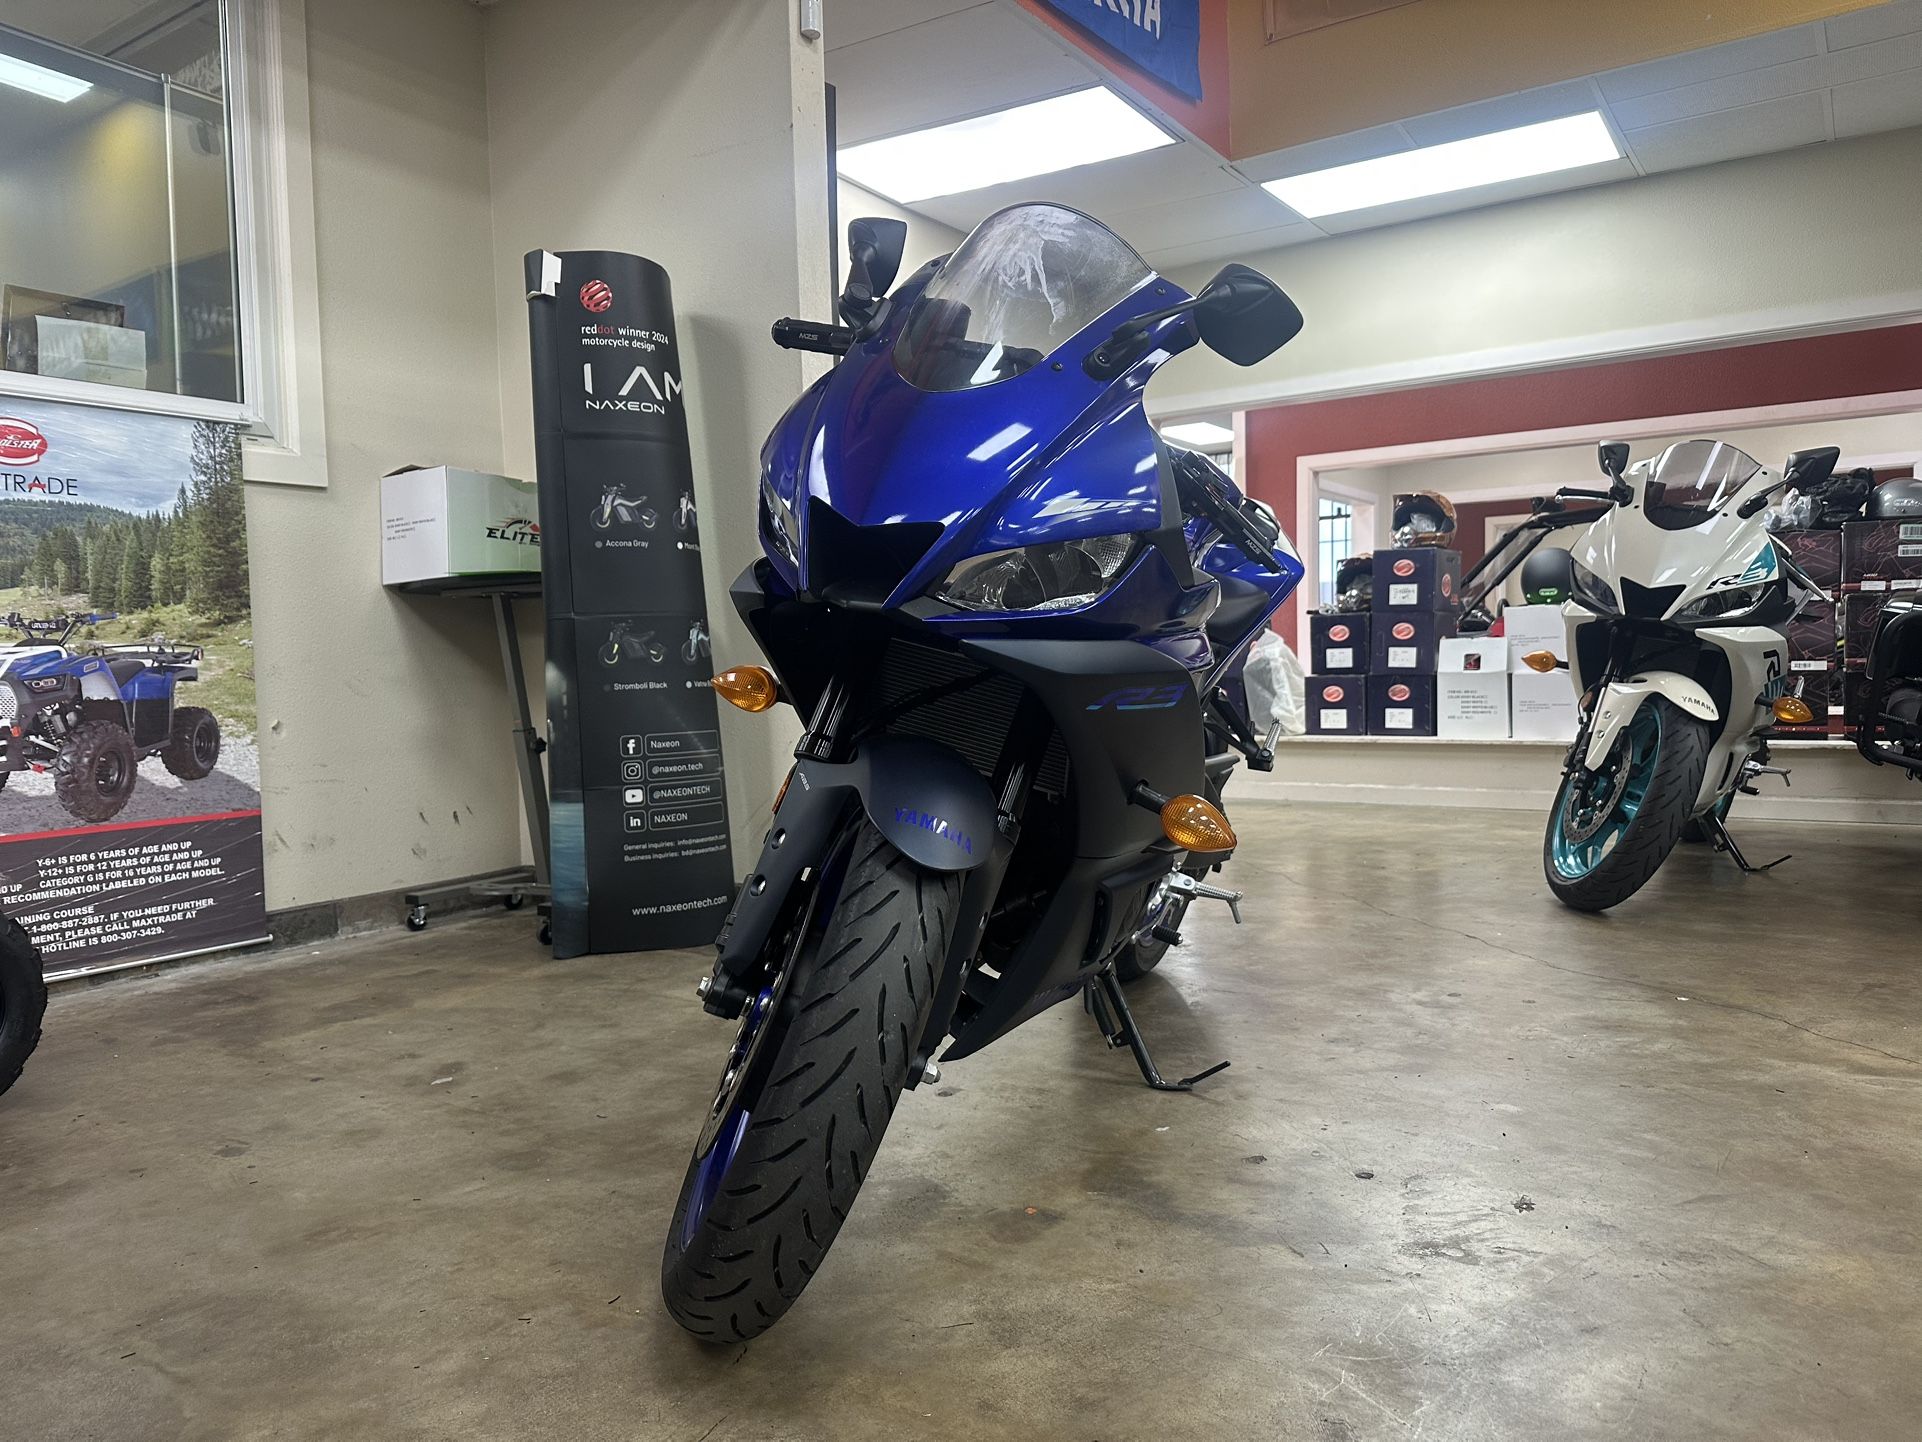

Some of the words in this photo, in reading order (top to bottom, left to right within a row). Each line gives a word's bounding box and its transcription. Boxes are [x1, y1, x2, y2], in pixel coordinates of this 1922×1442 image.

[581, 324, 614, 334] reddot
[618, 326, 649, 338] winner
[651, 331, 668, 344] 2024
[582, 337, 629, 348] motorcycle
[631, 339, 655, 352] design
[583, 363, 592, 395] I
[585, 400, 665, 415] NAXEON
[486, 527, 540, 544] ELITE
[633, 539, 649, 549] Gray
[614, 682, 649, 690] Stromboli
[1682, 696, 1715, 715] YAMAHA
[650, 740, 680, 749] Naxeon
[652, 762, 703, 775] @naxeon.tech
[653, 785, 711, 799] @NAXEONTECH
[654, 813, 688, 823] NAXEON
[895, 806, 973, 856] YAMAHA
[36, 858, 56, 867] Y-6+
[58, 856, 67, 864] IS
[69, 853, 88, 863] FOR
[90, 852, 95, 860] 6
[97, 849, 126, 859] YEARS
[128, 847, 140, 856] OF
[142, 845, 159, 854] AGE
[161, 842, 178, 852] AND
[180, 841, 192, 849] UP
[39, 868, 63, 878] Y-12+
[65, 866, 74, 874] IS
[76, 864, 95, 873] FOR
[97, 862, 107, 870] 12
[109, 857, 138, 868] YEARS
[140, 856, 151, 865] OF
[153, 854, 170, 862] AGE
[172, 851, 189, 861] AND
[191, 850, 203, 858] UP
[39, 876, 85, 889] CATEGORY
[95, 872, 104, 880] IS
[105, 870, 122, 880] FOR
[124, 869, 134, 877] 16
[135, 865, 161, 876] YEARS
[163, 863, 174, 872] OF
[176, 861, 192, 870] AGE
[193, 859, 210, 868] AND
[211, 857, 221, 865] UP
[3, 884, 100, 905] RECOMMENDATION
[102, 877, 145, 891] LABELED
[148, 875, 162, 884] ON
[164, 872, 189, 882] EACH
[192, 867, 225, 878] MODEL.
[10, 884, 22, 893] UP
[53, 905, 95, 919] COURSE
[110, 912, 119, 921] IF
[122, 909, 142, 919] YOU
[145, 905, 169, 915] NEED
[172, 898, 214, 911] FURTHER
[632, 895, 728, 915] www.naxeontech.com
[65, 926, 102, 939] PLEASE
[105, 921, 130, 932] CALL
[132, 911, 183, 927] MAXTRADE
[185, 910, 197, 919] AT
[41, 937, 86, 954] HOTLINE
[89, 937, 98, 945] IS
[101, 926, 165, 943] 800-307-3429.
